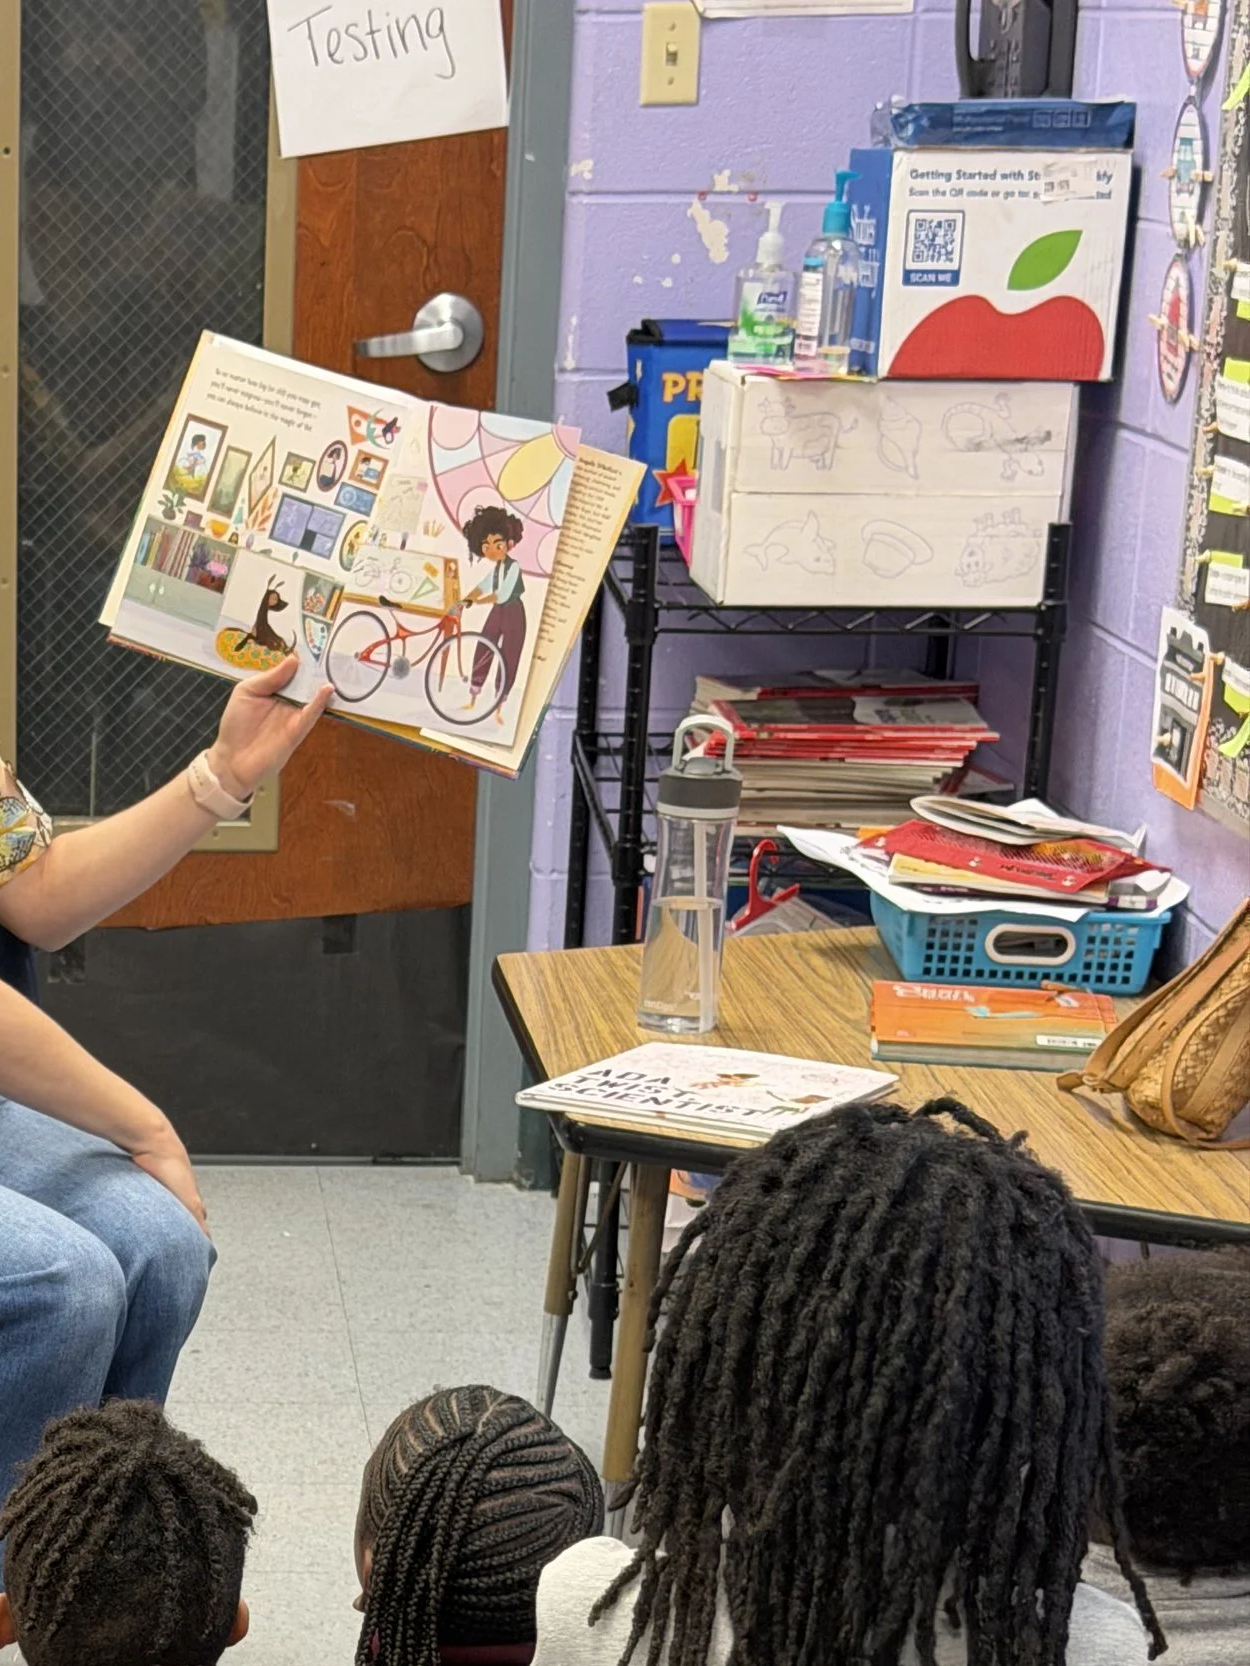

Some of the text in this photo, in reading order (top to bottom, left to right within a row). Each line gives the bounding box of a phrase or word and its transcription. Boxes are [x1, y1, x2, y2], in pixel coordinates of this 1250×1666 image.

[287, 4, 456, 80] Testing
[910, 168, 952, 183] Getting
[956, 168, 997, 181] Started
[1000, 169, 1024, 181] with
[909, 186, 929, 197] Scan
[932, 187, 947, 197] the
[950, 187, 964, 197] QR
[966, 189, 988, 198] code
[991, 190, 1000, 198] or
[1003, 190, 1015, 200] go
[910, 272, 952, 283] SCAN ME
[586, 1069, 671, 1085] ADA
[548, 1083, 765, 1117] SCIENTIST
